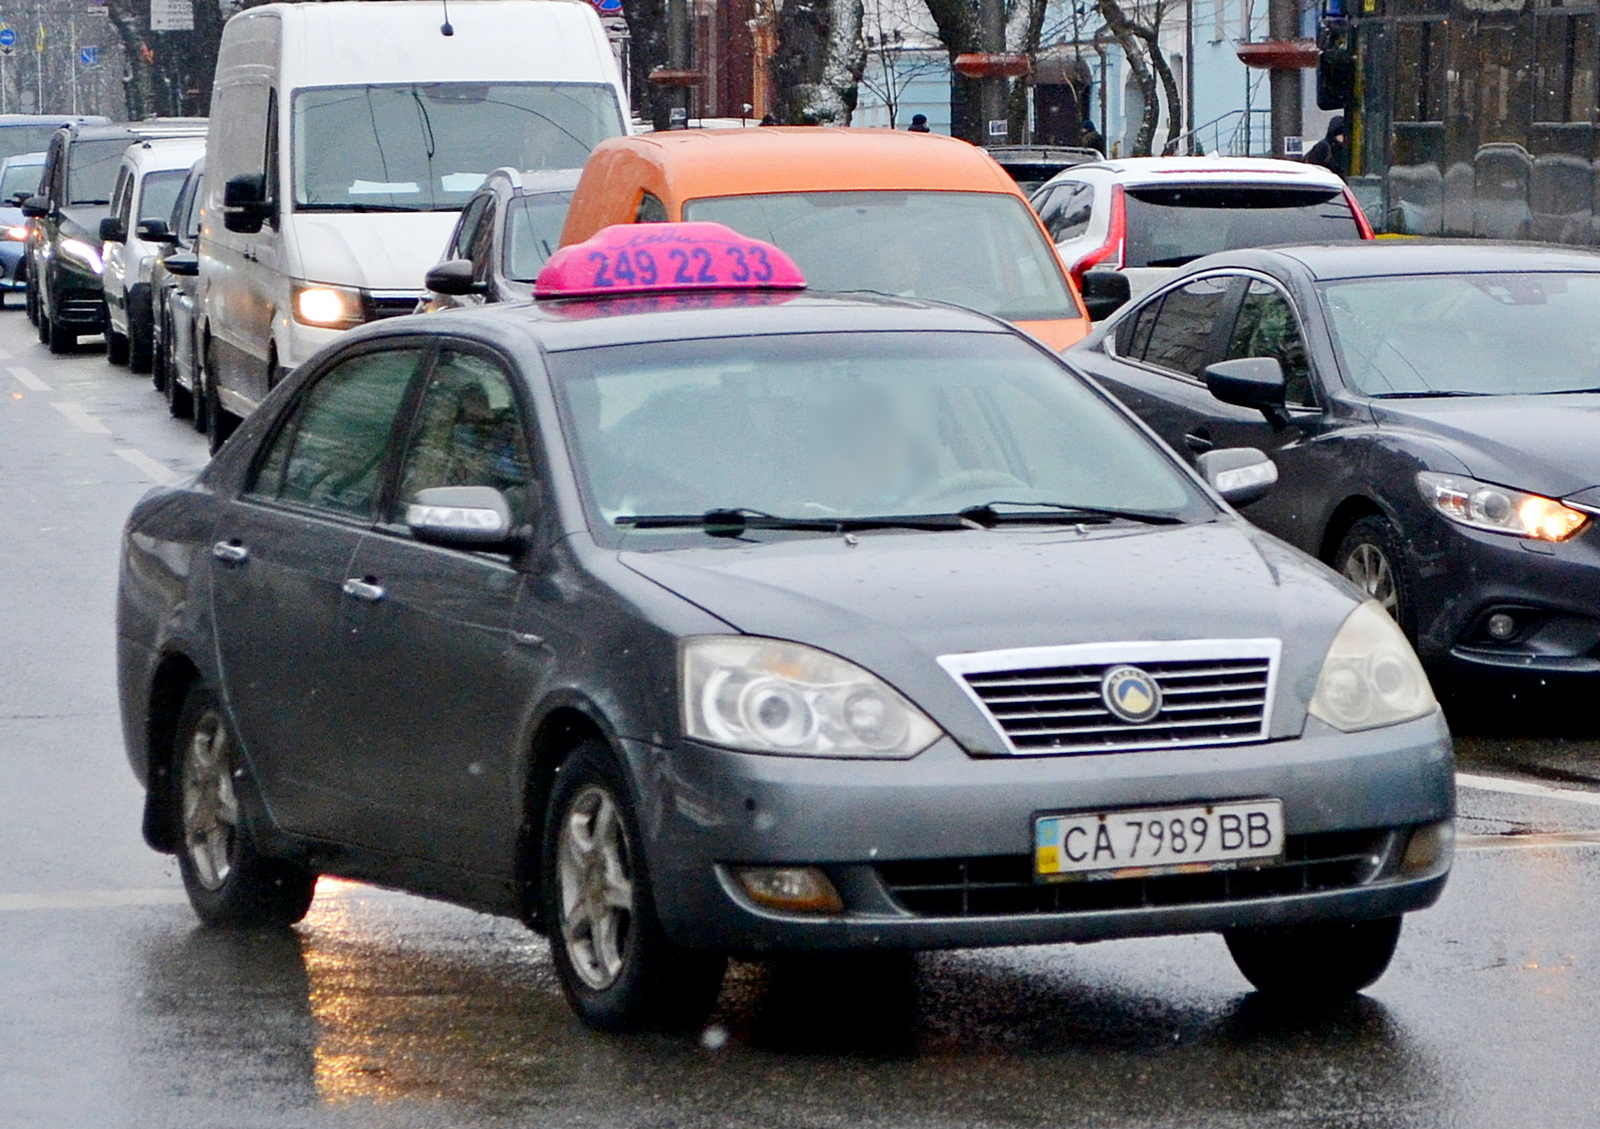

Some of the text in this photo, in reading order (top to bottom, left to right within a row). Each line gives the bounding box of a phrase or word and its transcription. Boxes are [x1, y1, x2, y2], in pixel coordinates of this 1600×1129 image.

[590, 246, 773, 287] 249 22 33
[1064, 812, 1271, 862] CA 7989 BB
